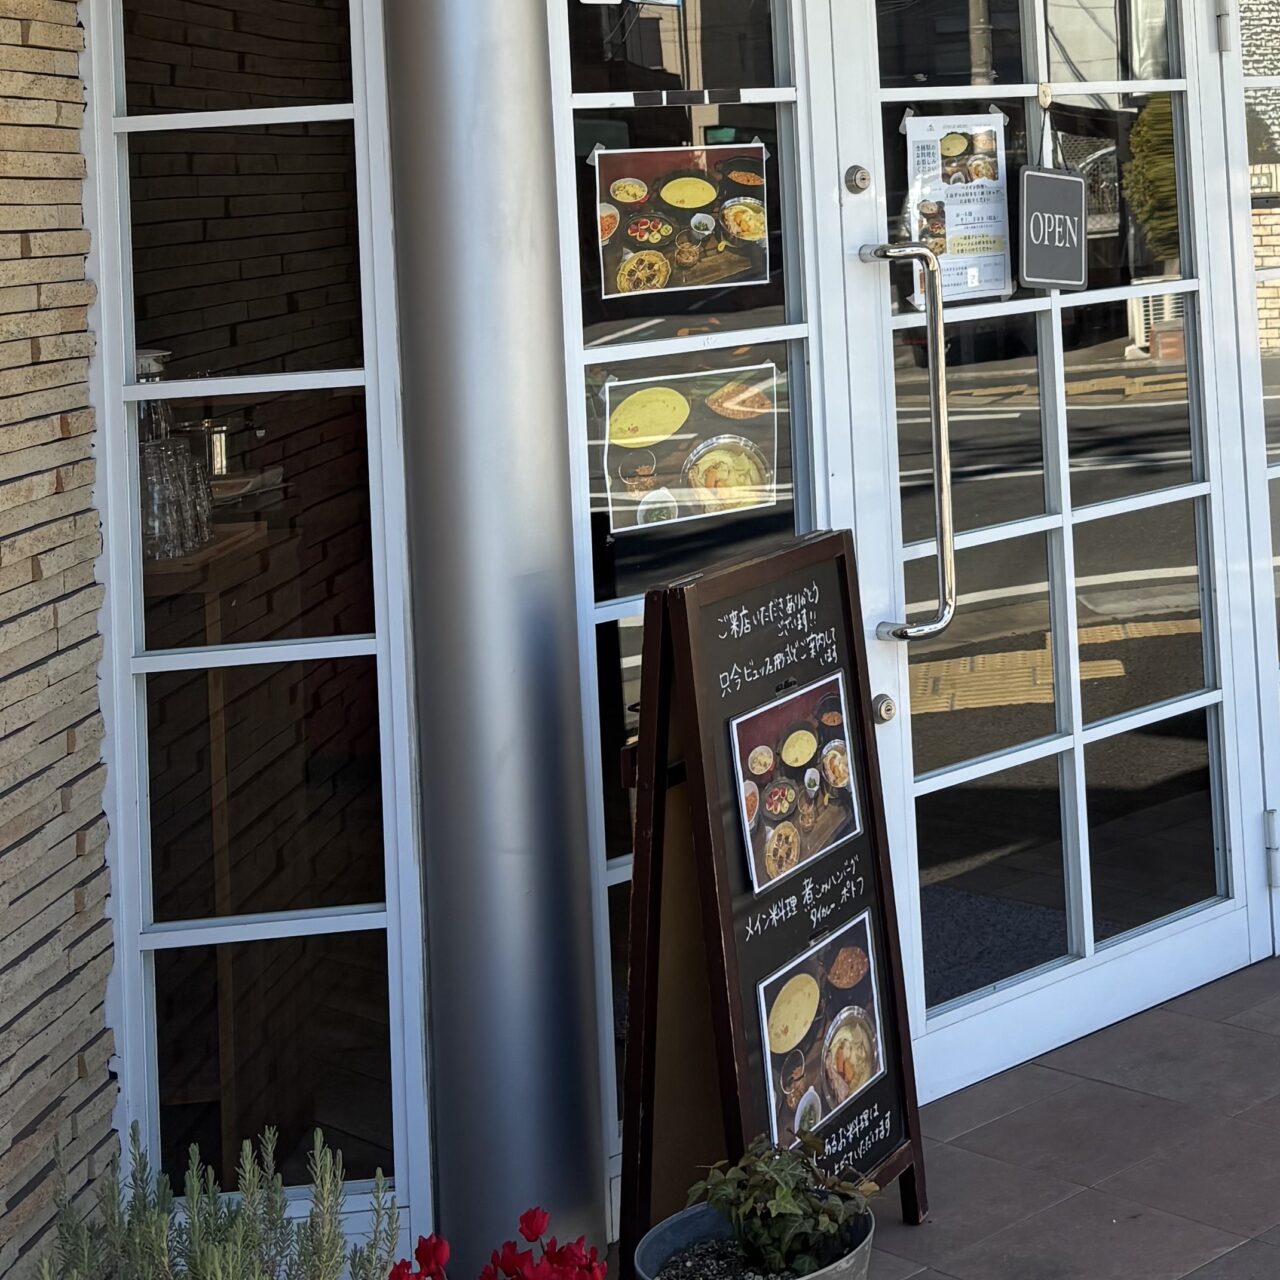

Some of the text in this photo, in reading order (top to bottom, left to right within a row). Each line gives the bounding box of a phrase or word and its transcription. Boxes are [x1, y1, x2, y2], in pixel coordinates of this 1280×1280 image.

[1029, 211, 1079, 248] OPEN
[745, 895, 798, 942] メイン料理
